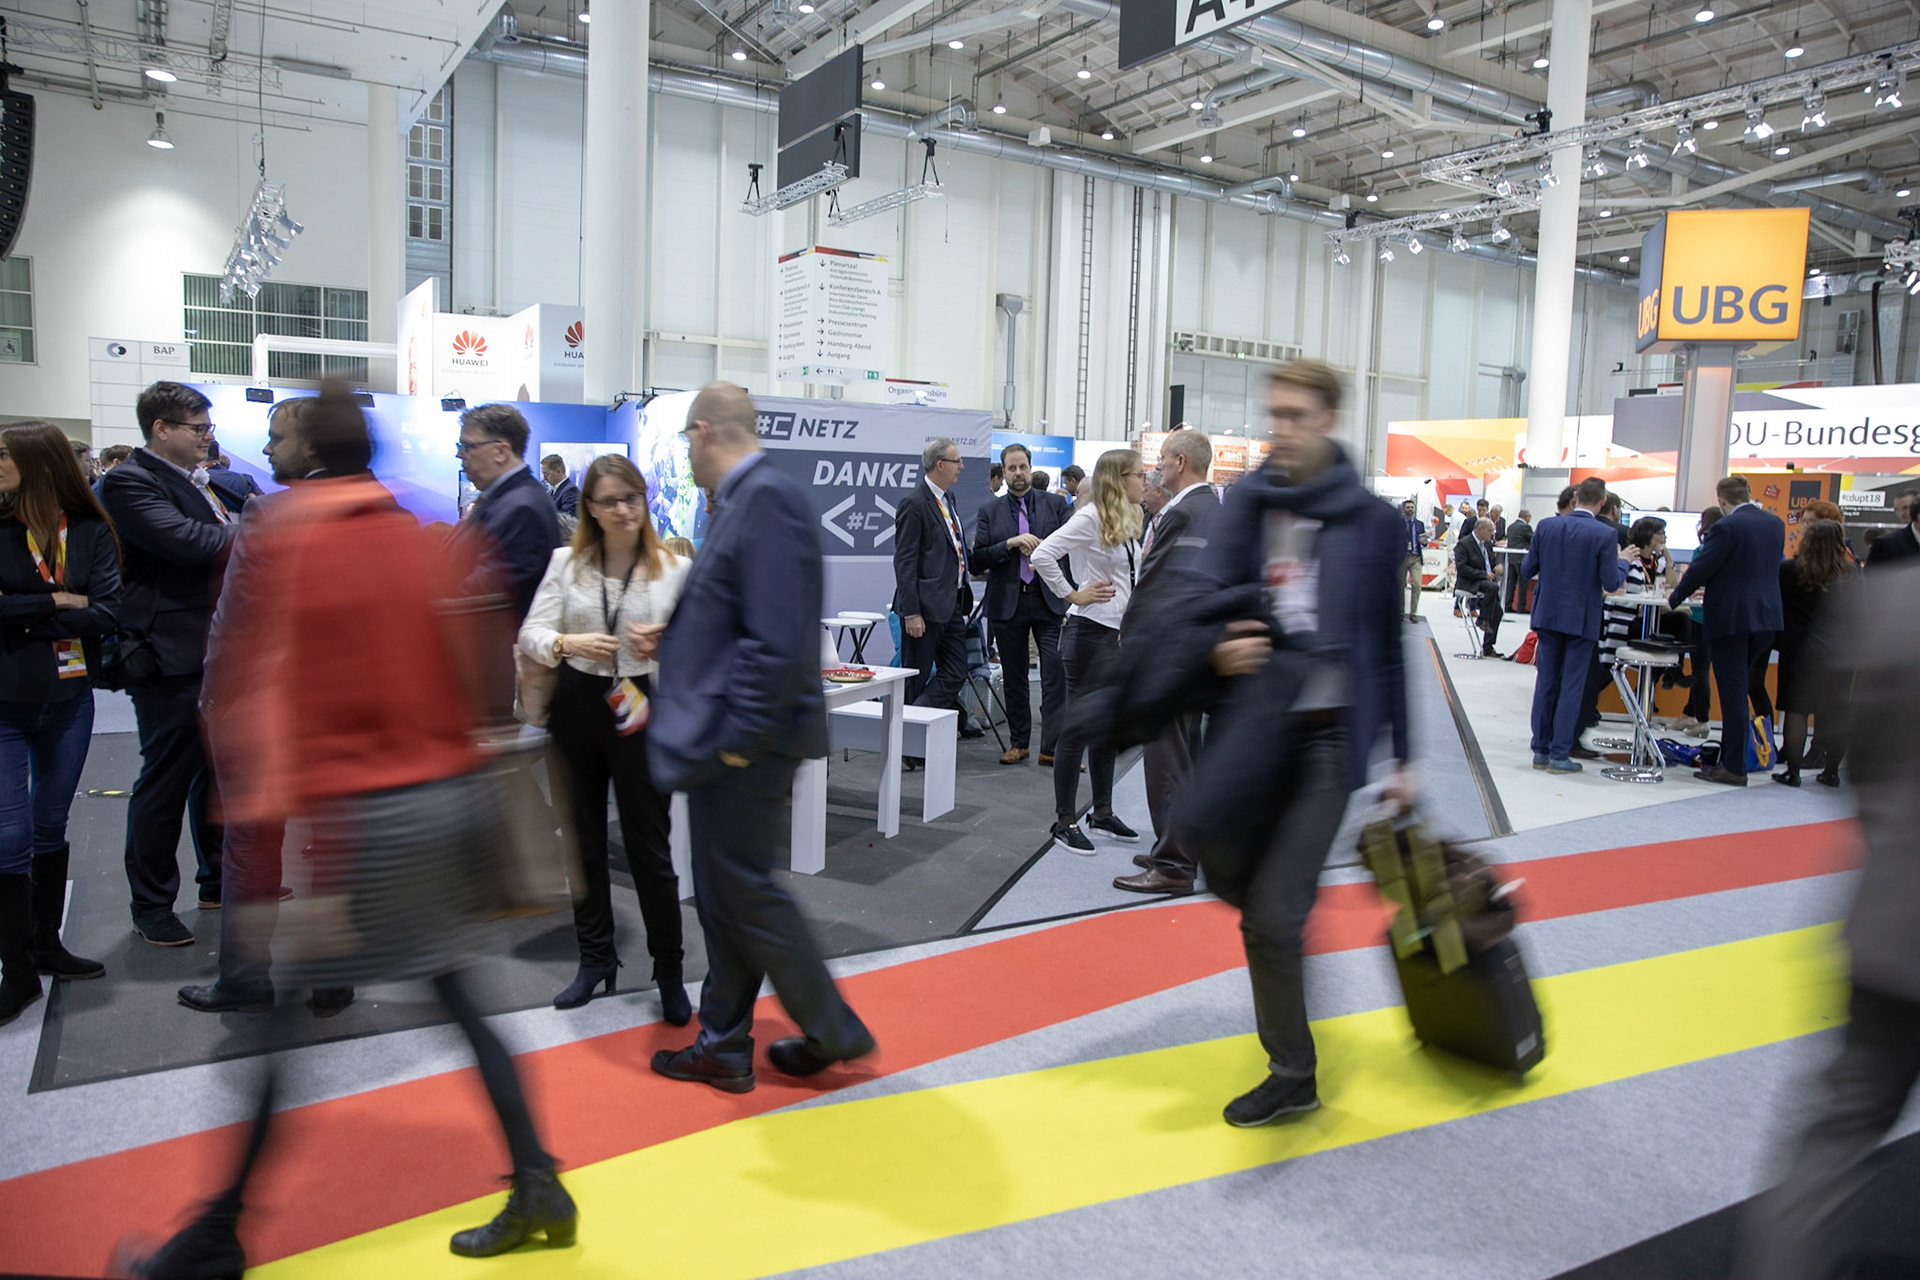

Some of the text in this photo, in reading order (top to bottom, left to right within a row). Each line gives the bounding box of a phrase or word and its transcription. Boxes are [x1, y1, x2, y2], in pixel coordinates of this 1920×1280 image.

[830, 260, 858, 269] Plenarsaal
[830, 284, 876, 295] Konferenzbereich
[1673, 285, 1788, 325] UBG
[1638, 288, 1659, 339] UBG
[828, 319, 867, 328] Pressezentrum
[828, 330, 862, 338] Gastronomie
[153, 345, 175, 355] BAP
[827, 351, 851, 360] Ausgang
[452, 358, 489, 366] HUAWEI
[798, 418, 859, 439] NETZ
[812, 460, 919, 488] DANKE
[1842, 493, 1881, 504] #cdupt18
